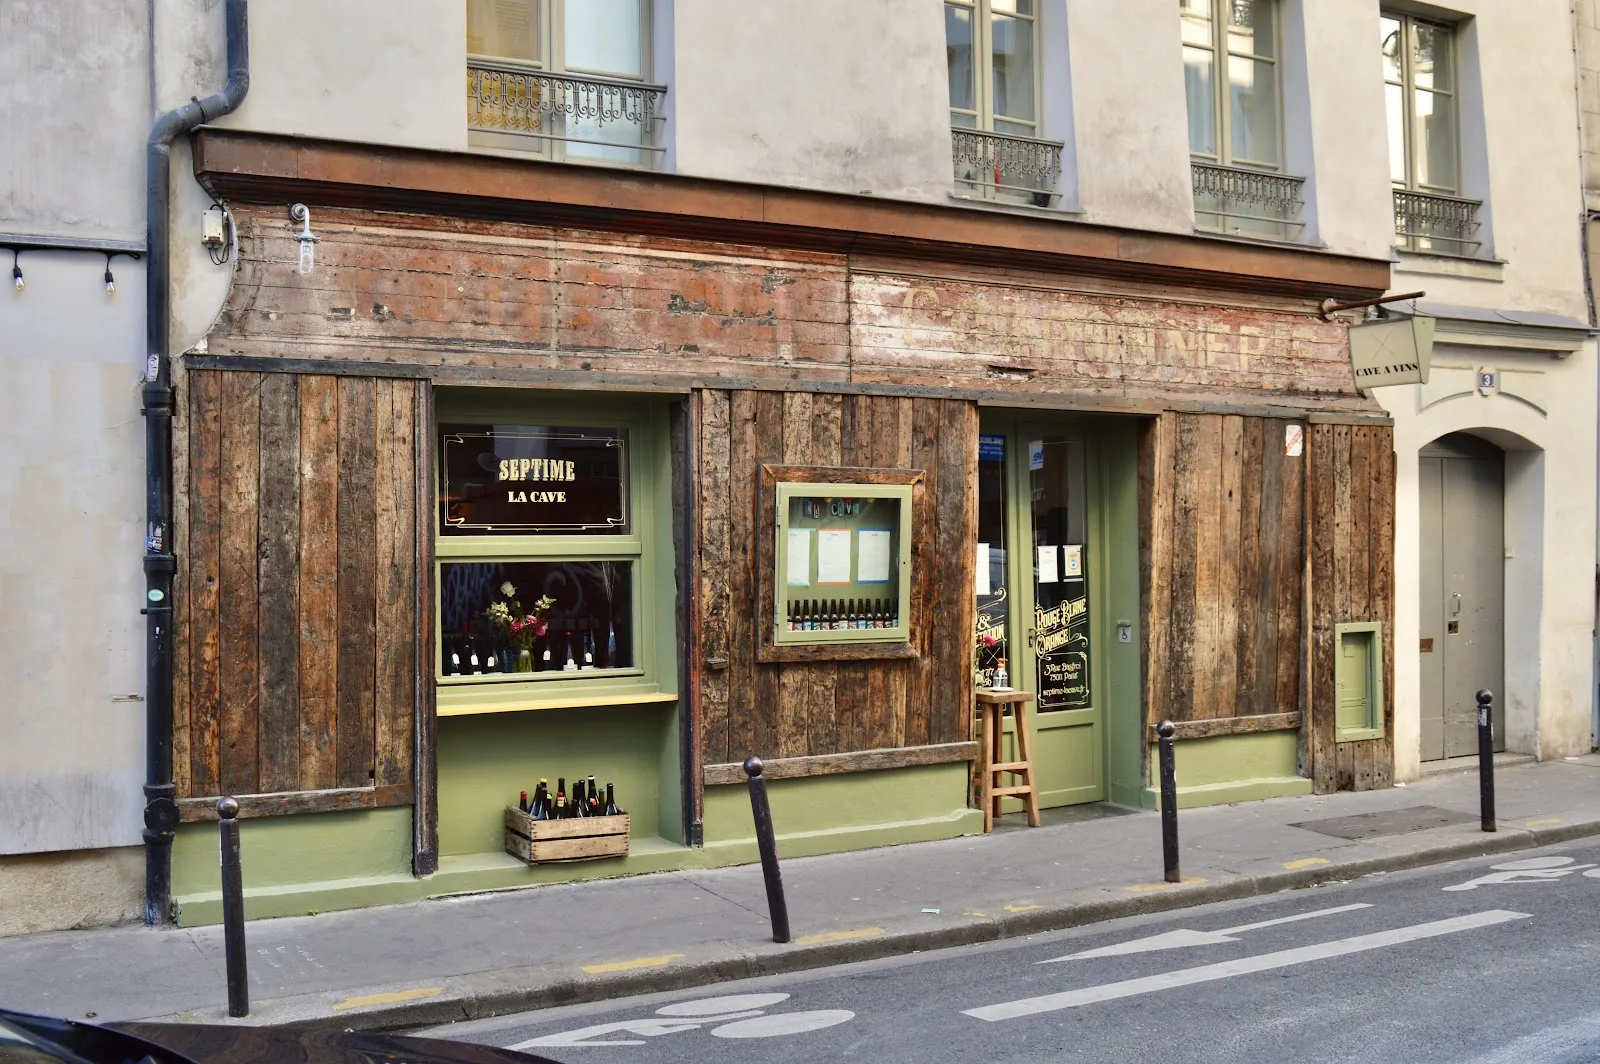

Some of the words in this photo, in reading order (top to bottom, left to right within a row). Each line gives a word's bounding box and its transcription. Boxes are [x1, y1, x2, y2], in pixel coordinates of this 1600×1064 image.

[1356, 367, 1380, 377] CAVE
[1384, 365, 1391, 375] A
[1393, 362, 1418, 373] VINS
[1484, 374, 1491, 385] 3
[498, 458, 576, 482] SEPTIME
[508, 491, 527, 503] LA
[530, 491, 567, 503] CAVE
[978, 613, 991, 630] &
[1036, 628, 1069, 658] ORANGE
